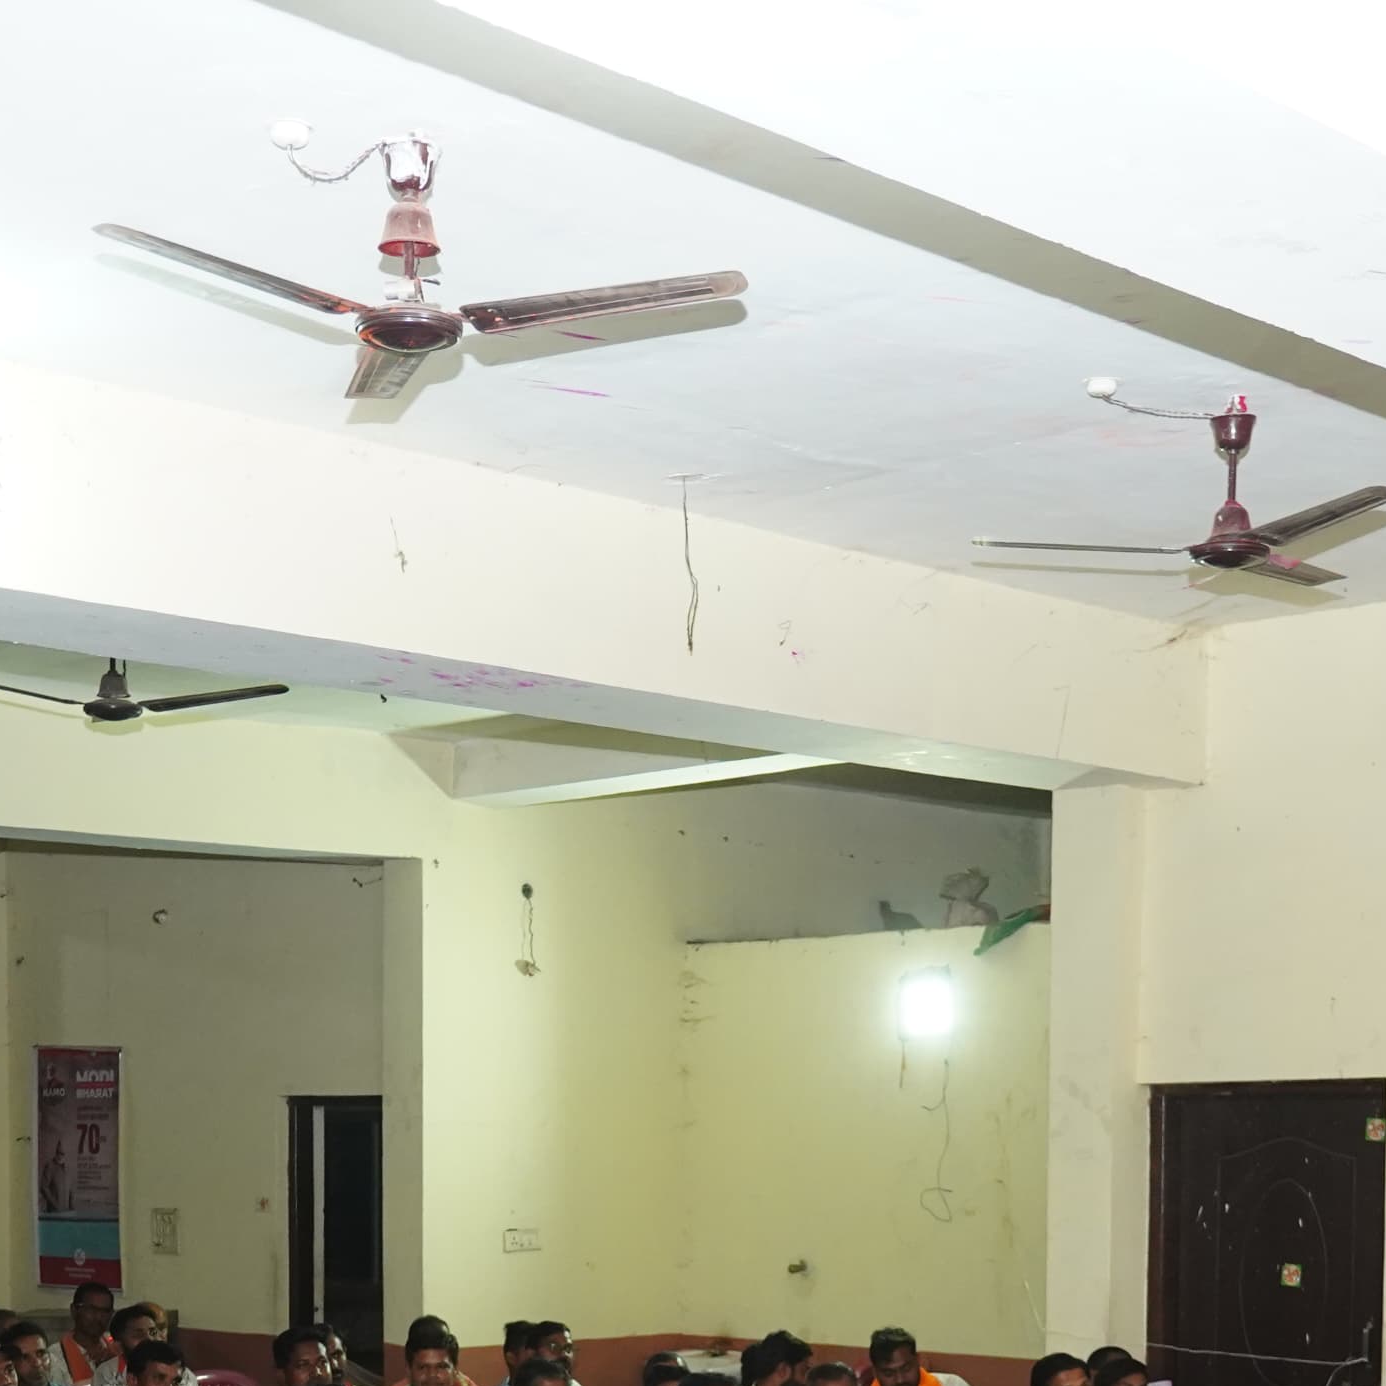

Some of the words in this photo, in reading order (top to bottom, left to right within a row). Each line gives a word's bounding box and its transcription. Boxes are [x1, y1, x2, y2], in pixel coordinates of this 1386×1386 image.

[76, 1070, 114, 1082] MODI
[76, 1087, 114, 1099] BHARAT
[76, 1124, 101, 1155] 70
